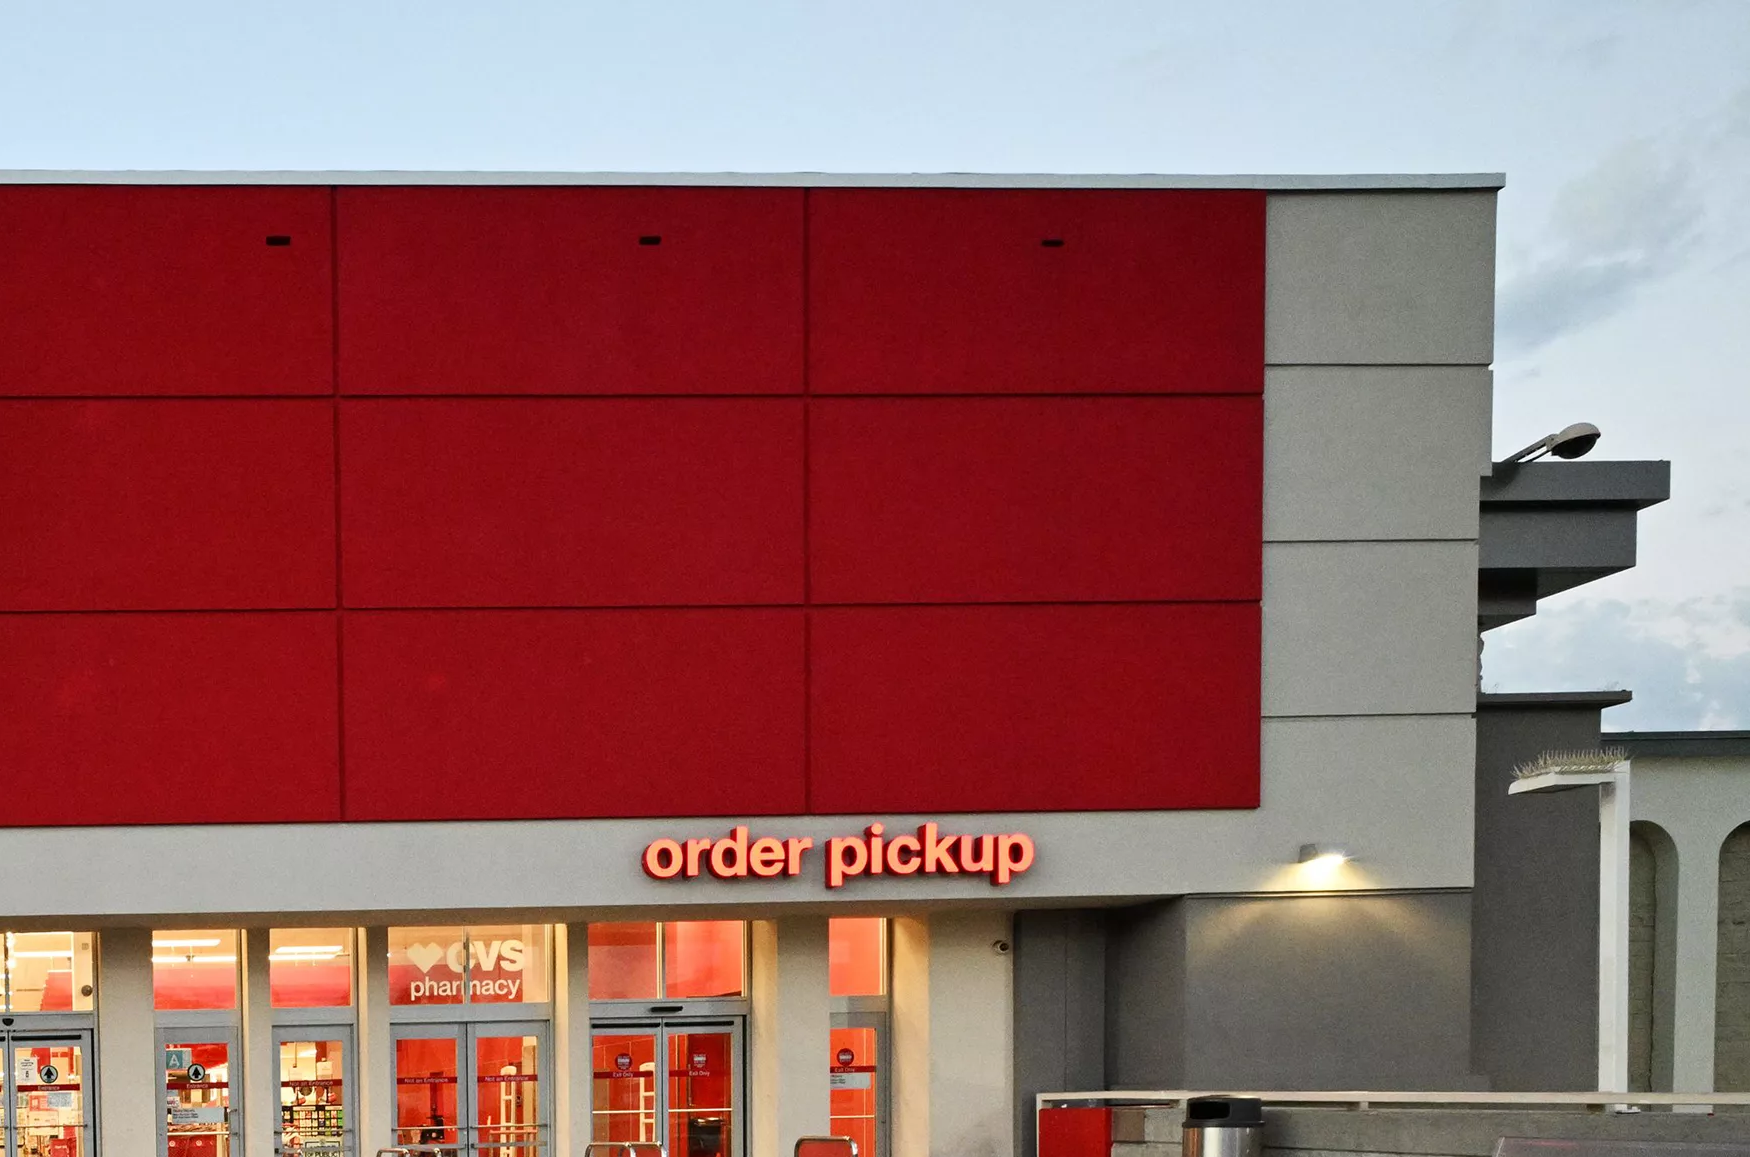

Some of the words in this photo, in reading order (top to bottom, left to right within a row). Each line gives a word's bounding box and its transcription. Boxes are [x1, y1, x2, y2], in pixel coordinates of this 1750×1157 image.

[642, 825, 813, 880] order
[825, 821, 1036, 889] pickup
[446, 939, 526, 973] CVS
[410, 976, 521, 1001] pharmacy
